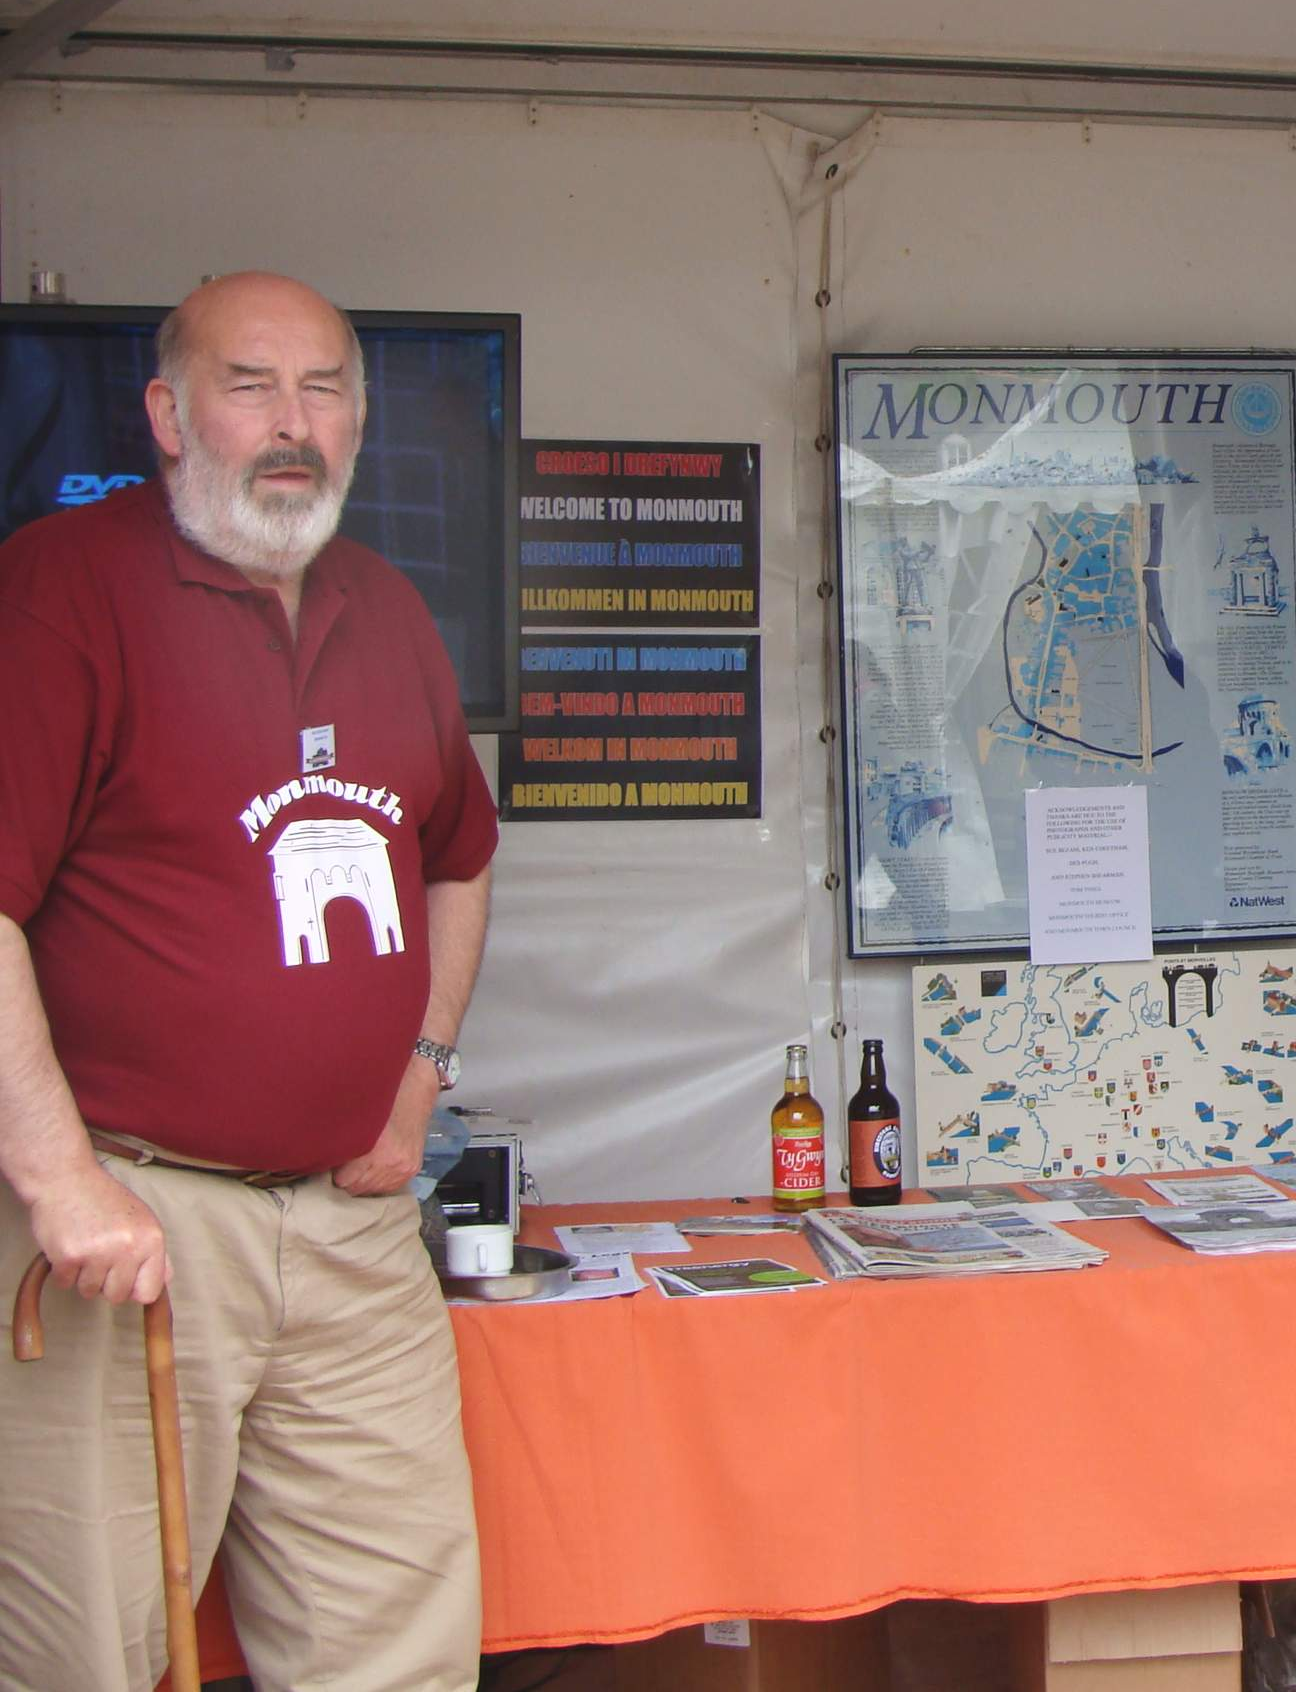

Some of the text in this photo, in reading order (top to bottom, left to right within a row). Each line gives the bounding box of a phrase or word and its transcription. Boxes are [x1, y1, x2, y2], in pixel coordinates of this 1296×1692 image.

[861, 382, 1233, 440] MONMOUTH
[536, 451, 610, 475] CROESO
[613, 452, 622, 475] I
[521, 497, 743, 522] WELCOME TO MONMOUTH
[635, 543, 743, 567] MONMOUTH
[521, 588, 754, 612] ILLKOMMEN IN MONMOUTH
[616, 647, 637, 671] IN
[640, 648, 747, 671] MONMOUTH
[638, 692, 745, 716] MONMOUTH
[522, 737, 737, 762] WELKOM IN MONMOUTH
[512, 782, 748, 808] BIENVENIDO A MONMOUTH
[238, 773, 405, 843] Monmouth
[1240, 895, 1285, 907] NatWest
[784, 1177, 822, 1188] CIDER
